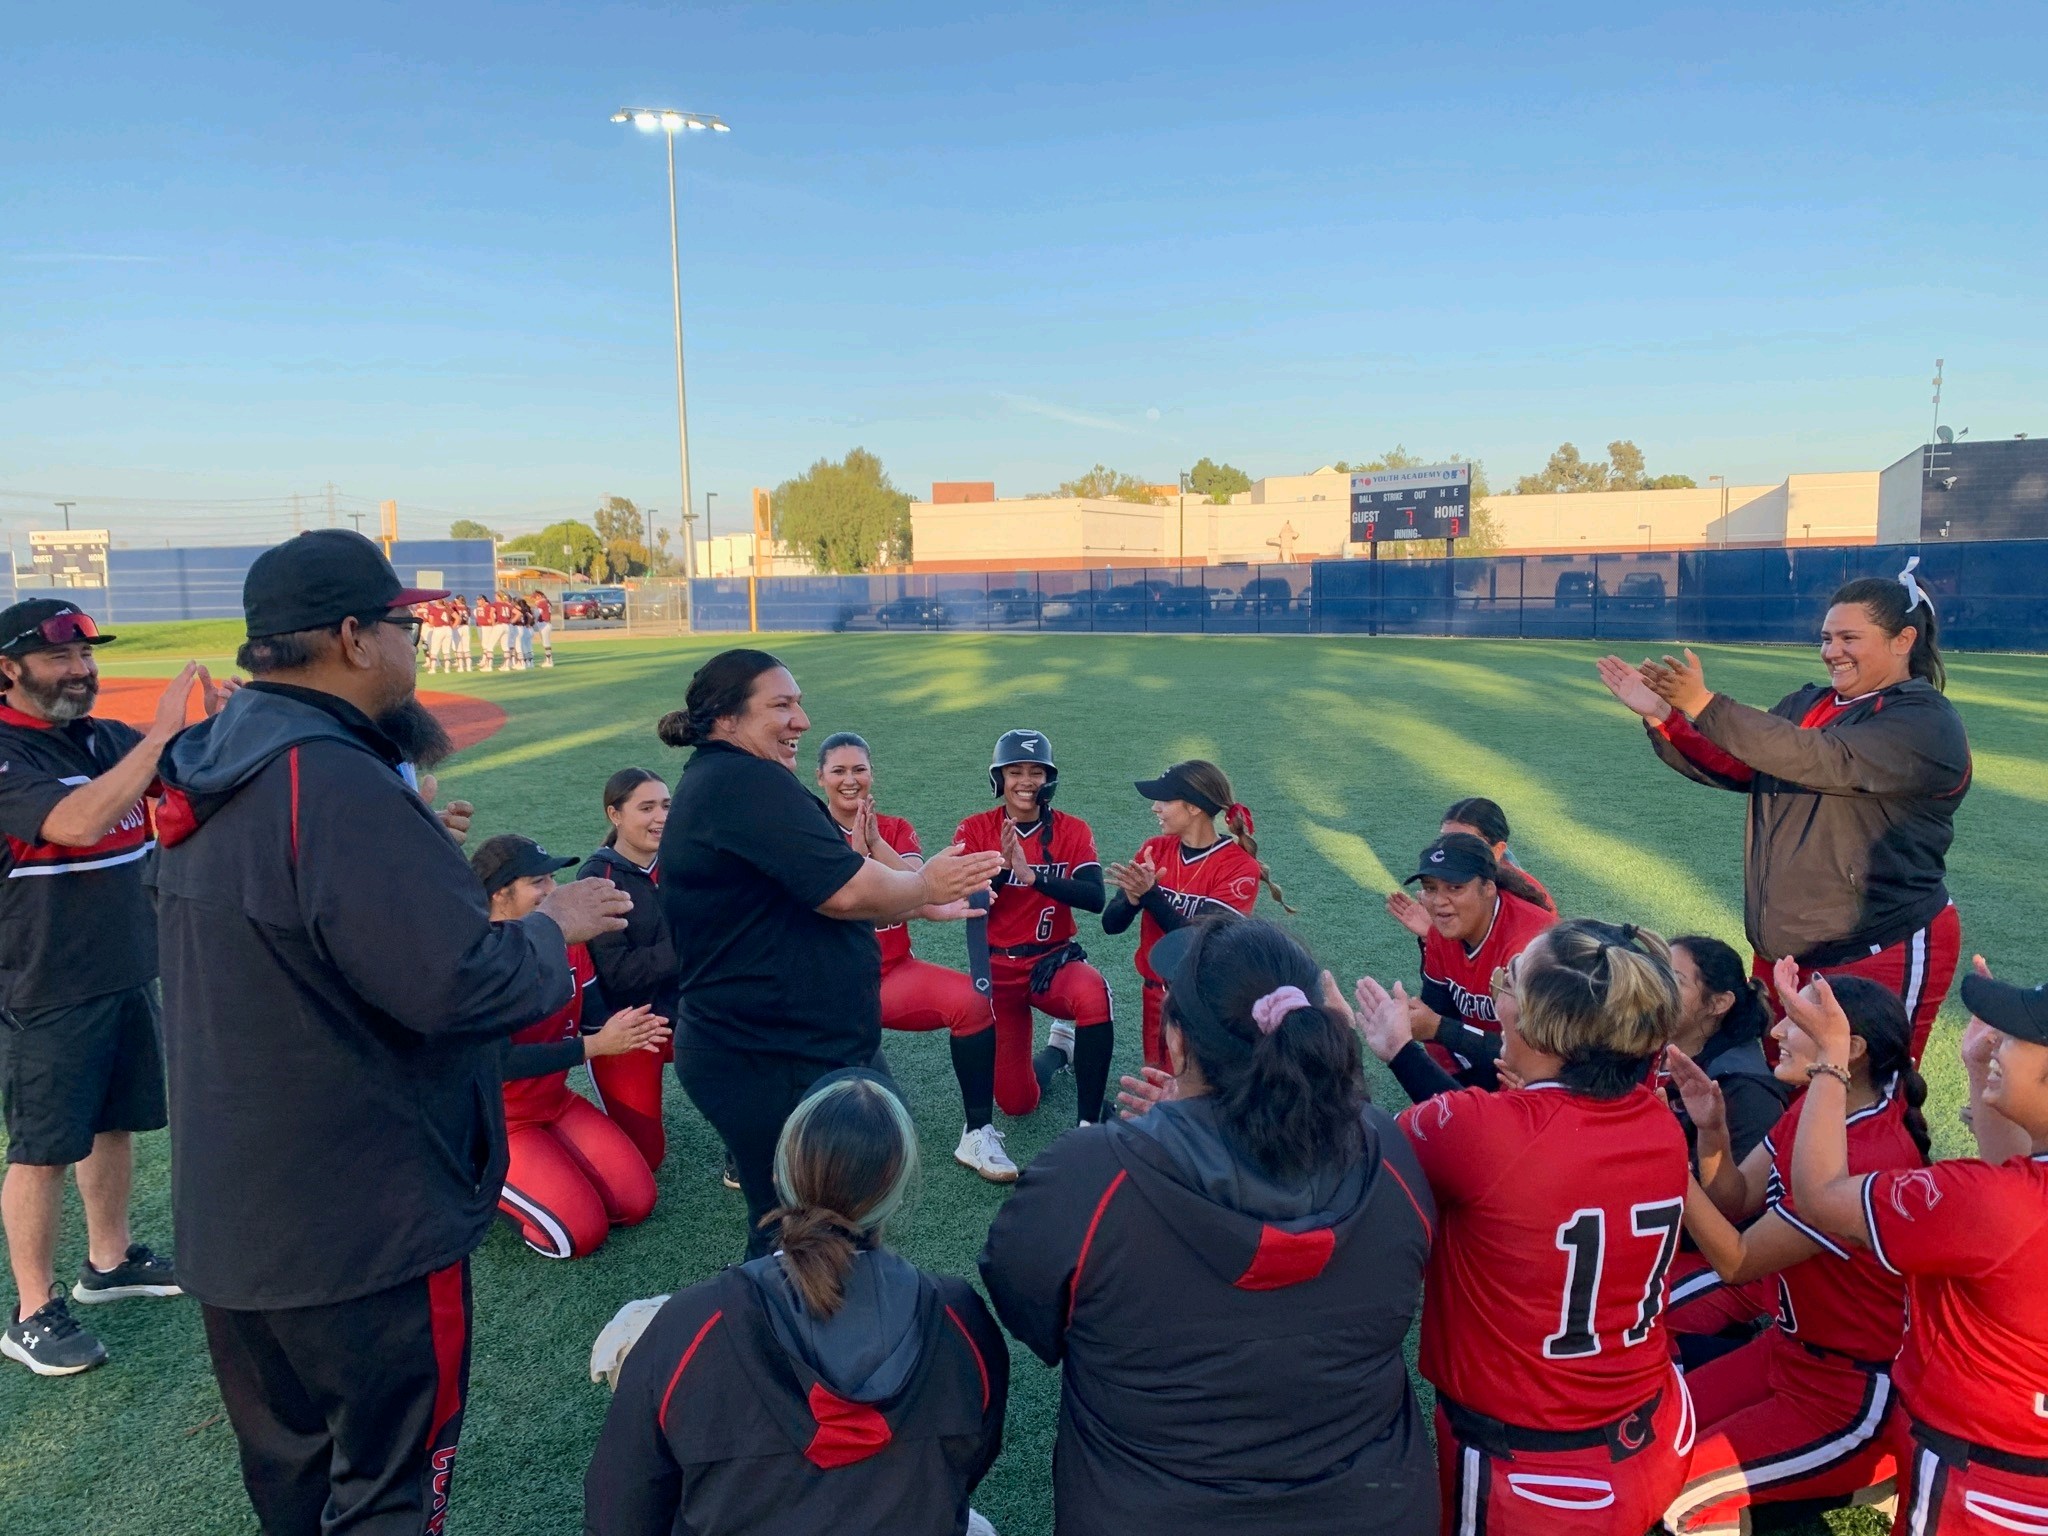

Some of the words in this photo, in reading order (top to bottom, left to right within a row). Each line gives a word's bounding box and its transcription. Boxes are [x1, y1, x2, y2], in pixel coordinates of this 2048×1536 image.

[1372, 474, 1399, 483] YOUTH
[1401, 470, 1441, 481] ACADEMY
[1359, 495, 1372, 503] BALL
[1383, 492, 1403, 502] STRIKE
[1414, 490, 1427, 499] OUT
[1440, 489, 1446, 498] H
[1453, 488, 1459, 496] E
[1352, 511, 1380, 524] GUEST
[1434, 505, 1464, 518] HOME
[1405, 510, 1414, 526] 7
[1366, 523, 1375, 539] 2
[1394, 529, 1418, 539] INNING
[1450, 518, 1459, 537] 3
[1430, 850, 1445, 863] C
[1036, 906, 1055, 942] 6
[1543, 1196, 1684, 1359] 17
[1618, 1413, 1646, 1449] C
